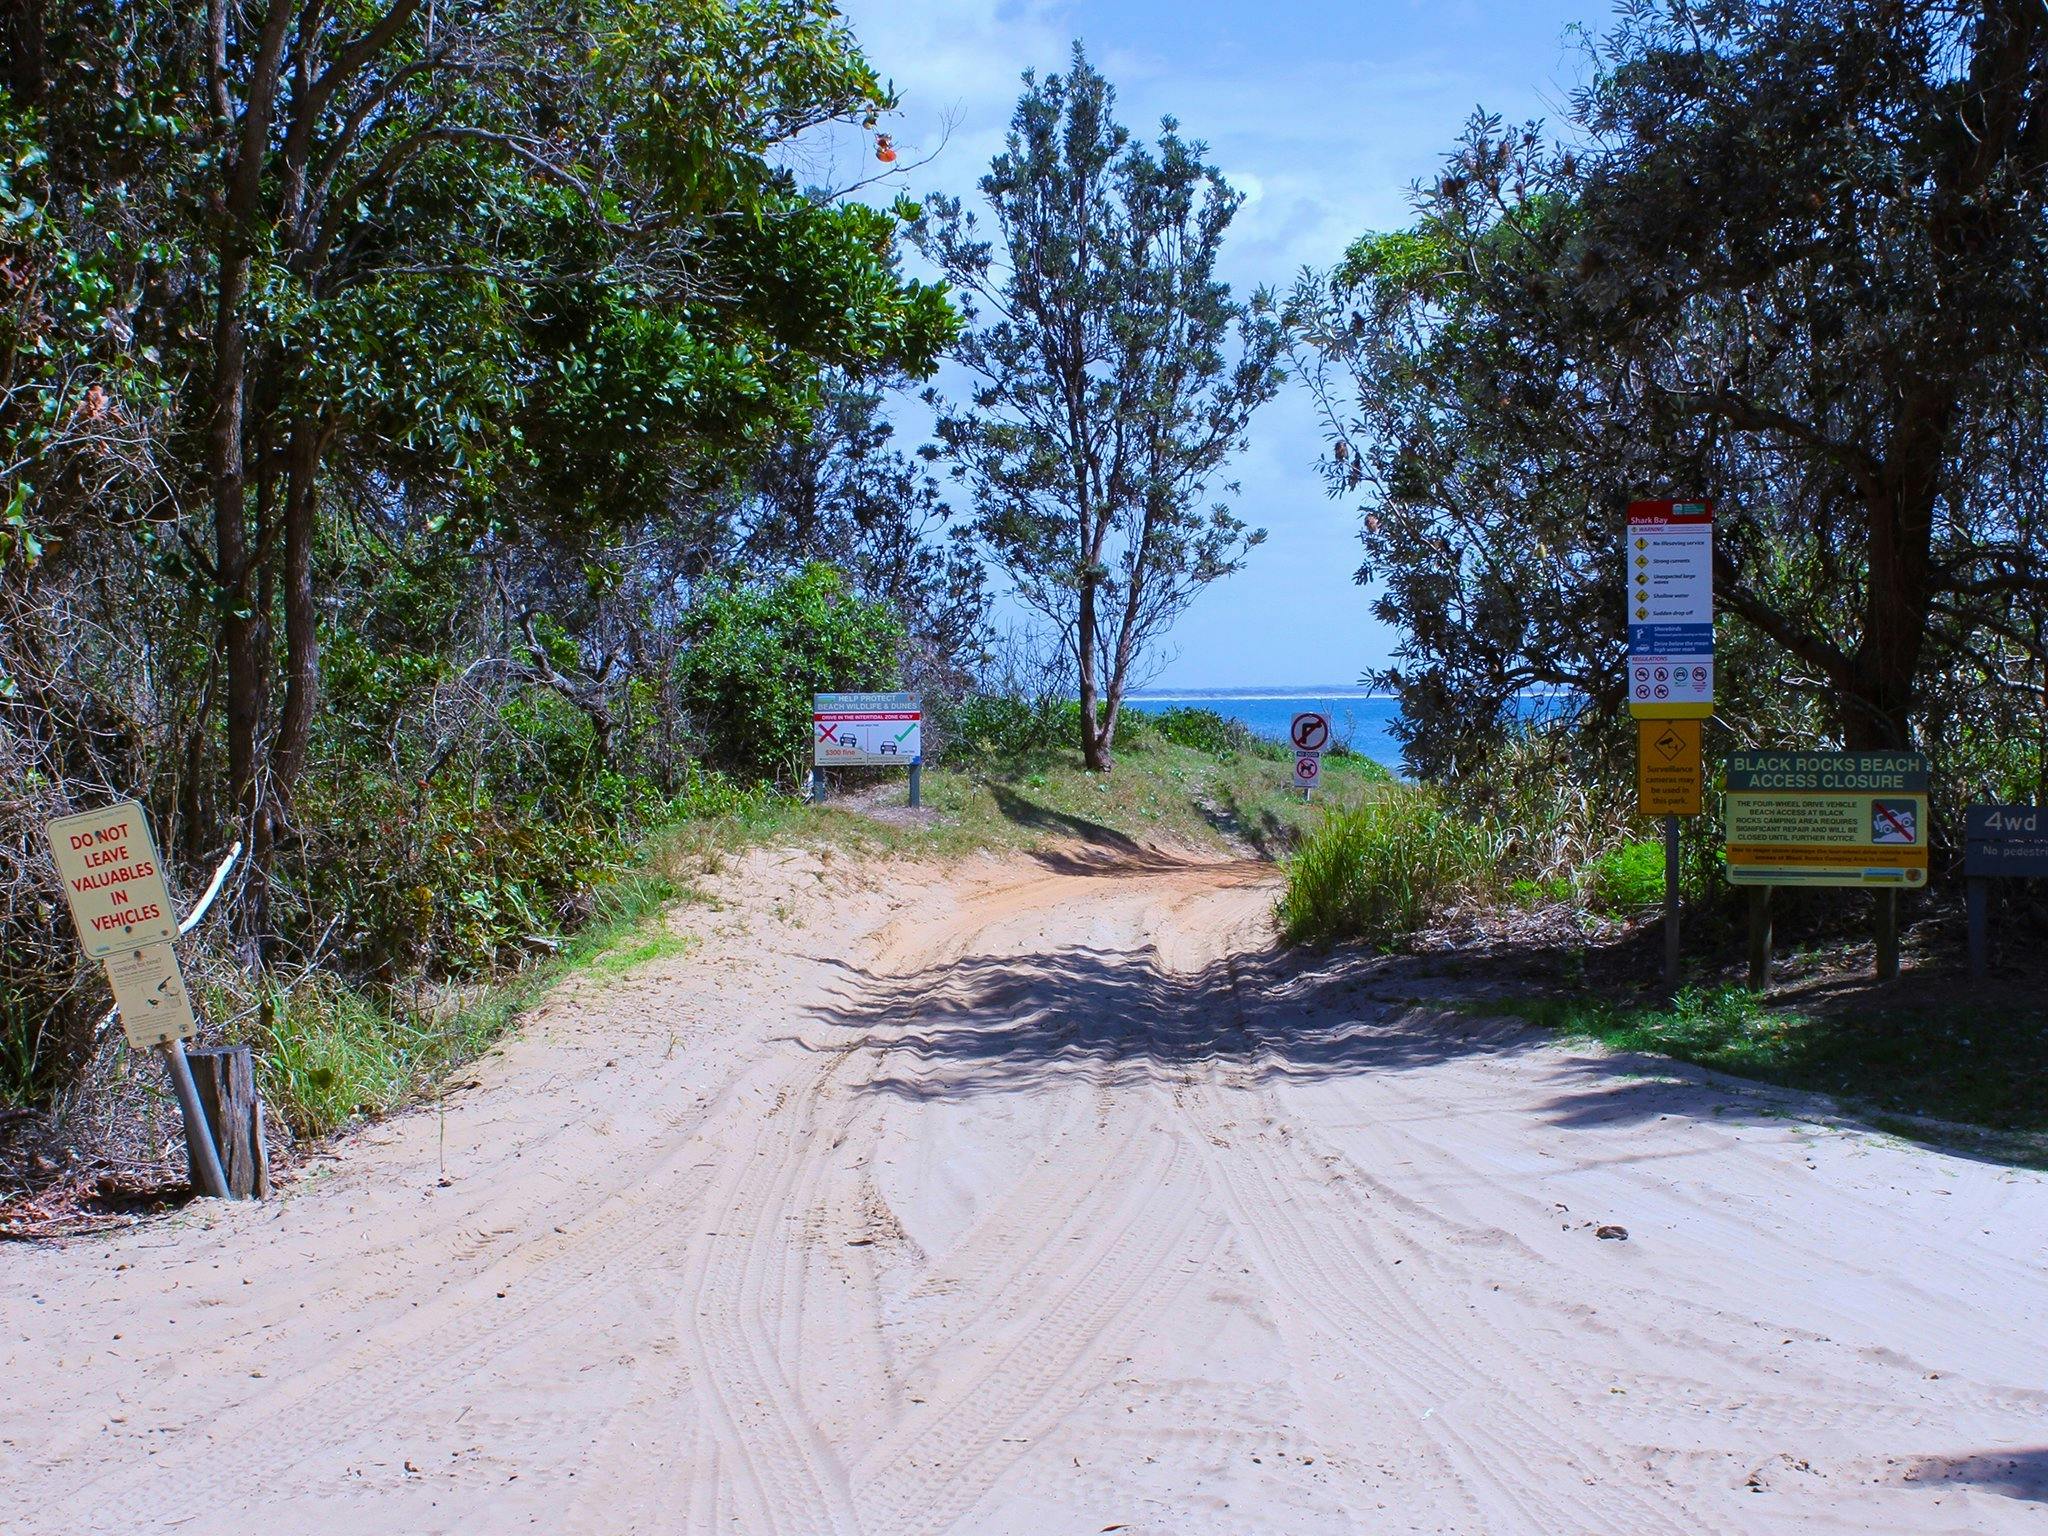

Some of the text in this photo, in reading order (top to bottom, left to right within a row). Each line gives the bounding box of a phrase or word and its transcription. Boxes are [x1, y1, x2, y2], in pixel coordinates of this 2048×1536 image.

[1654, 517, 1668, 526] Bay
[1647, 765, 1693, 773] Surveillance
[1734, 758, 1920, 772] BLACK ROCKS BEACH
[1679, 777, 1695, 785] may
[1749, 774, 1904, 788] ACCESS CLOSURE
[1668, 797, 1688, 806] park.
[1984, 811, 2036, 831] 4wd
[70, 824, 128, 850] DO NOT
[84, 846, 129, 868] LEAVE
[1983, 846, 1998, 855] No
[71, 862, 154, 892] VALUABLES
[110, 890, 128, 905] IN
[91, 904, 160, 931] VEHICLES
